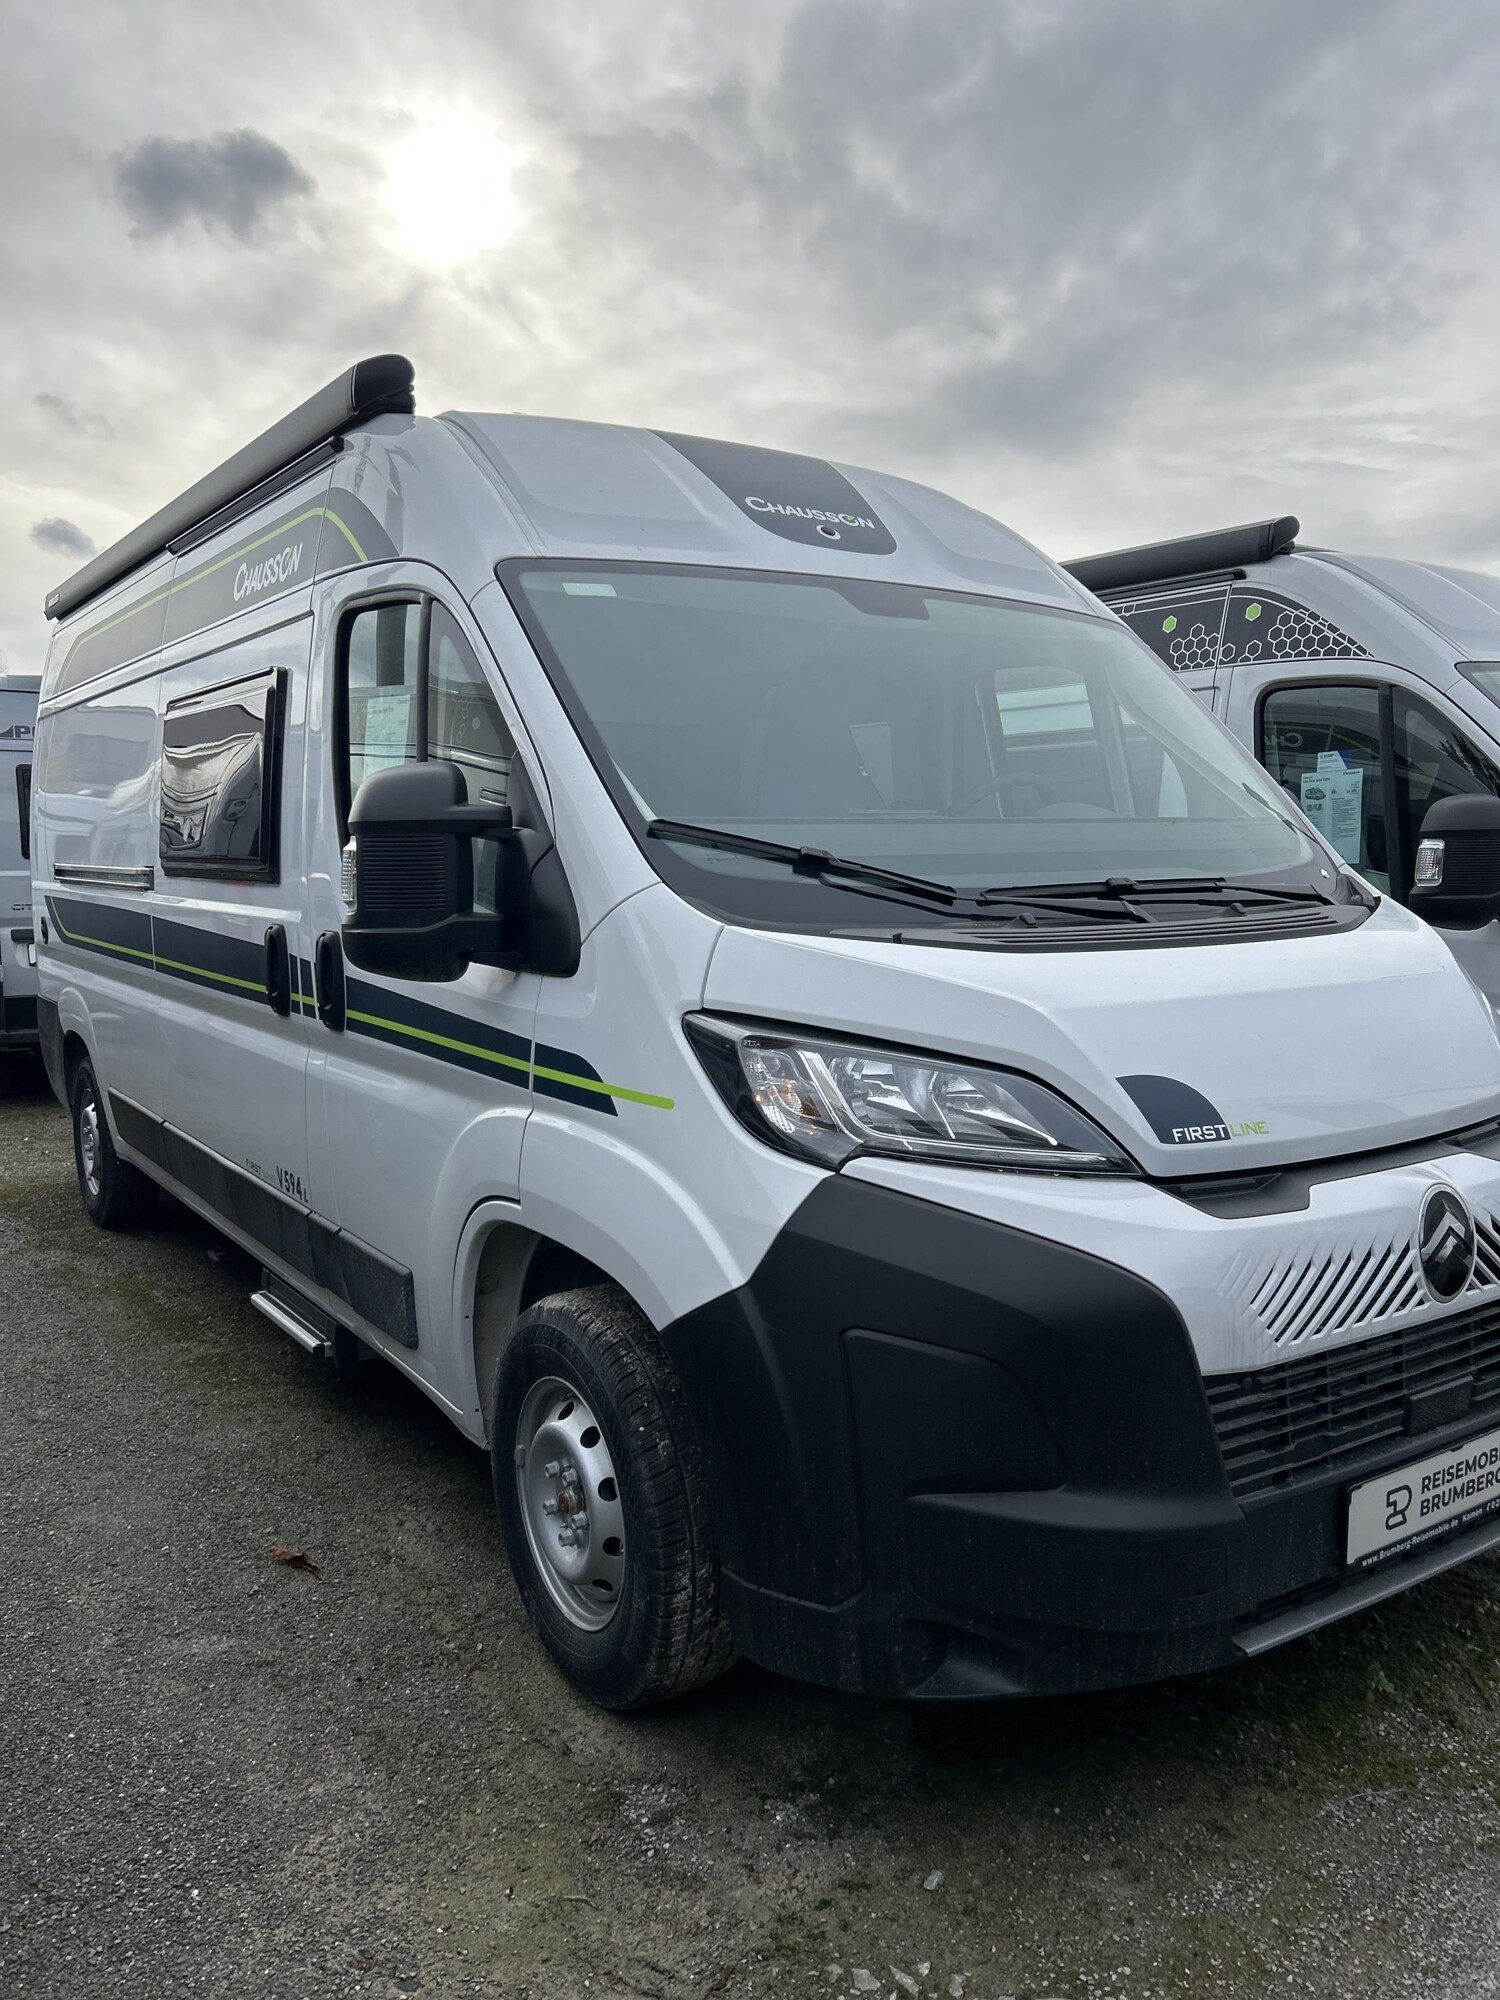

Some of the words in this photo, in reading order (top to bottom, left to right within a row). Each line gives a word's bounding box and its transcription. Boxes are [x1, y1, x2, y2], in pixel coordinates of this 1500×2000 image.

[744, 496, 875, 529] CHAUSSON
[233, 542, 303, 601] CHAUSSON
[1172, 1124, 1226, 1142] FIRST
[1229, 1121, 1270, 1137] LINE
[1421, 1446, 1500, 1494] REISEMOB
